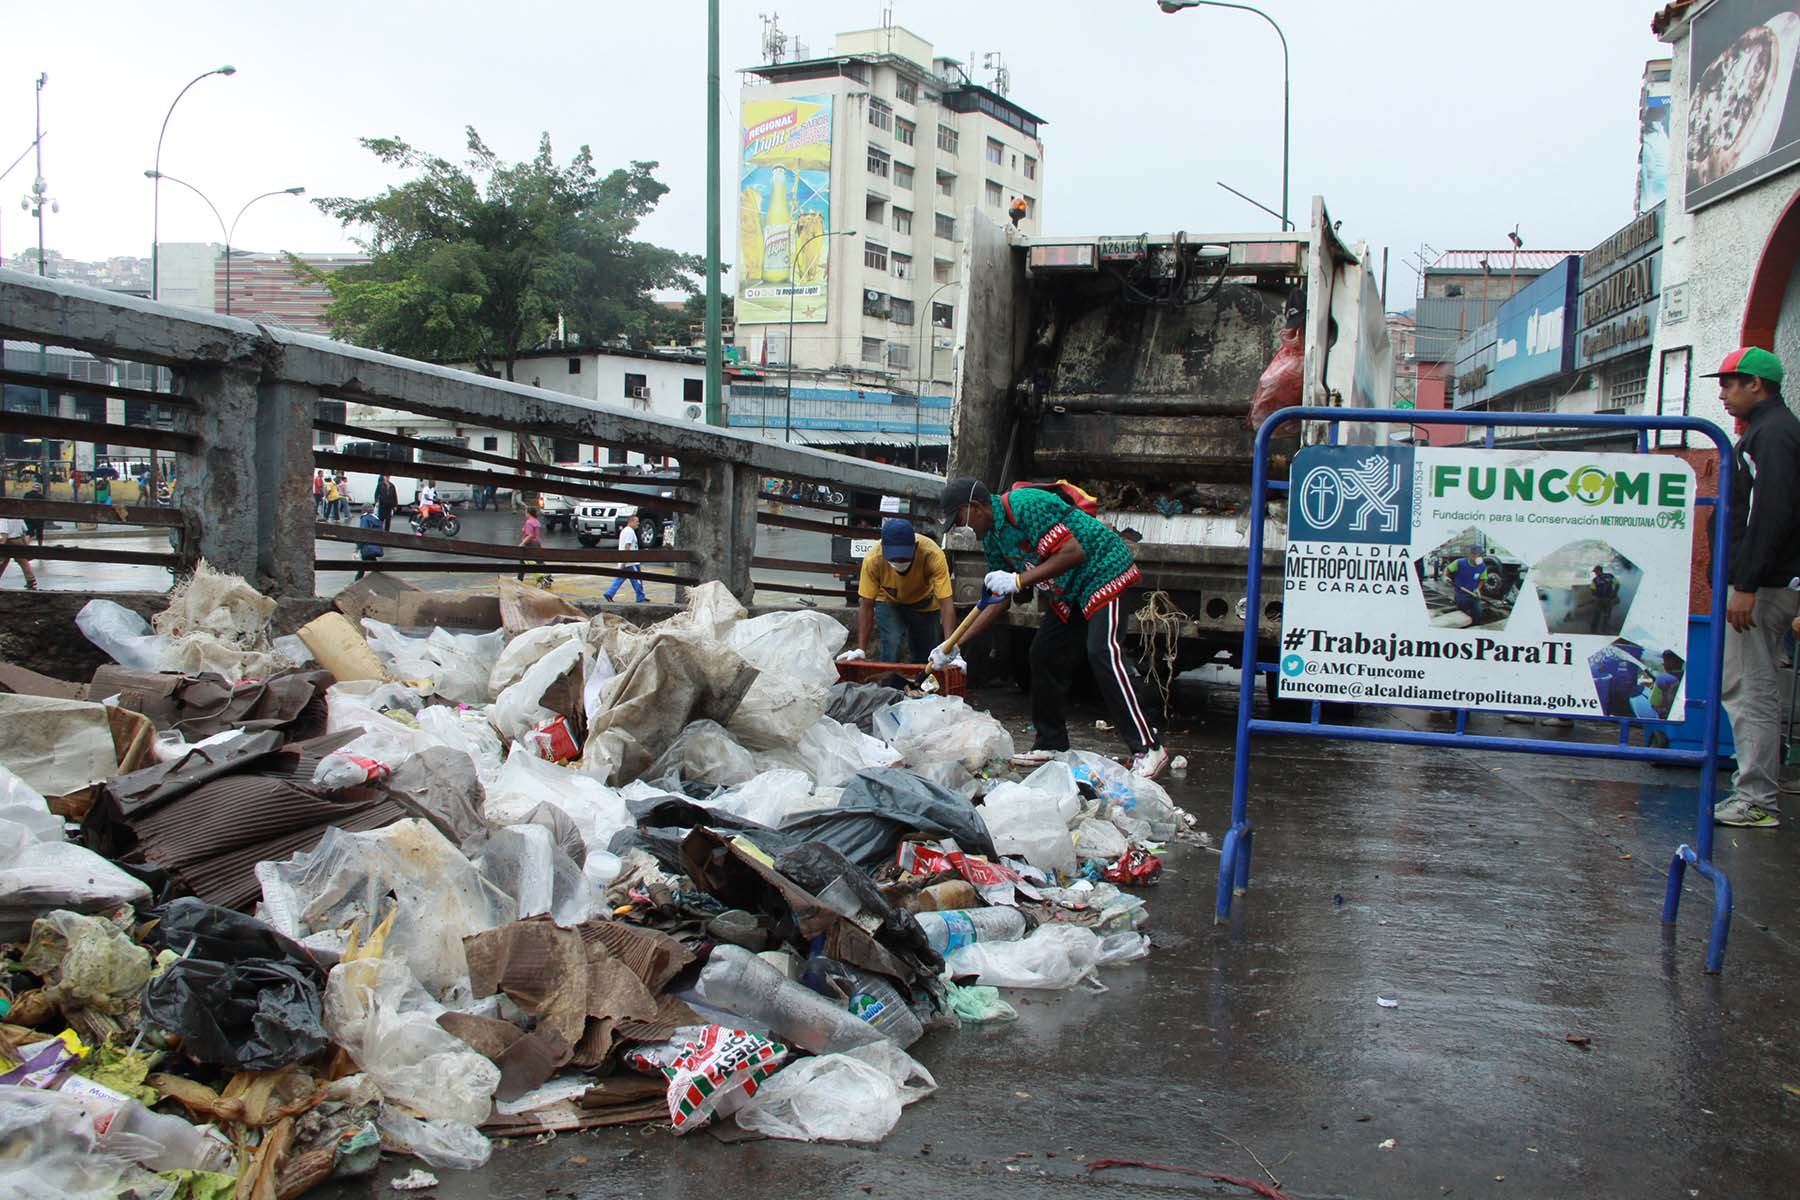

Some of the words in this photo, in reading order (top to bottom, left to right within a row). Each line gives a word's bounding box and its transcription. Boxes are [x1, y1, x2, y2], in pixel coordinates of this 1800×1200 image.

[748, 114, 793, 140] REGIONAL
[754, 130, 785, 154] Light
[1434, 464, 1687, 507] FUNCOME
[1433, 509, 1486, 521] Fundación
[1489, 514, 1513, 524] para
[1515, 513, 1525, 523] la
[1527, 513, 1599, 526] Conservación
[1601, 515, 1656, 528] METROPOLITANA
[1288, 544, 1410, 558] ALCALDÍA
[1286, 556, 1409, 582] METROPOLITANA
[1285, 580, 1307, 591] DE
[1317, 581, 1410, 596] CARACAS
[1283, 628, 1574, 665] #TrabajamosParaTi
[1304, 662, 1426, 680] @AMCFuncome
[1280, 679, 1599, 710] funcome@alcaldiametropolitana.gob.ve
